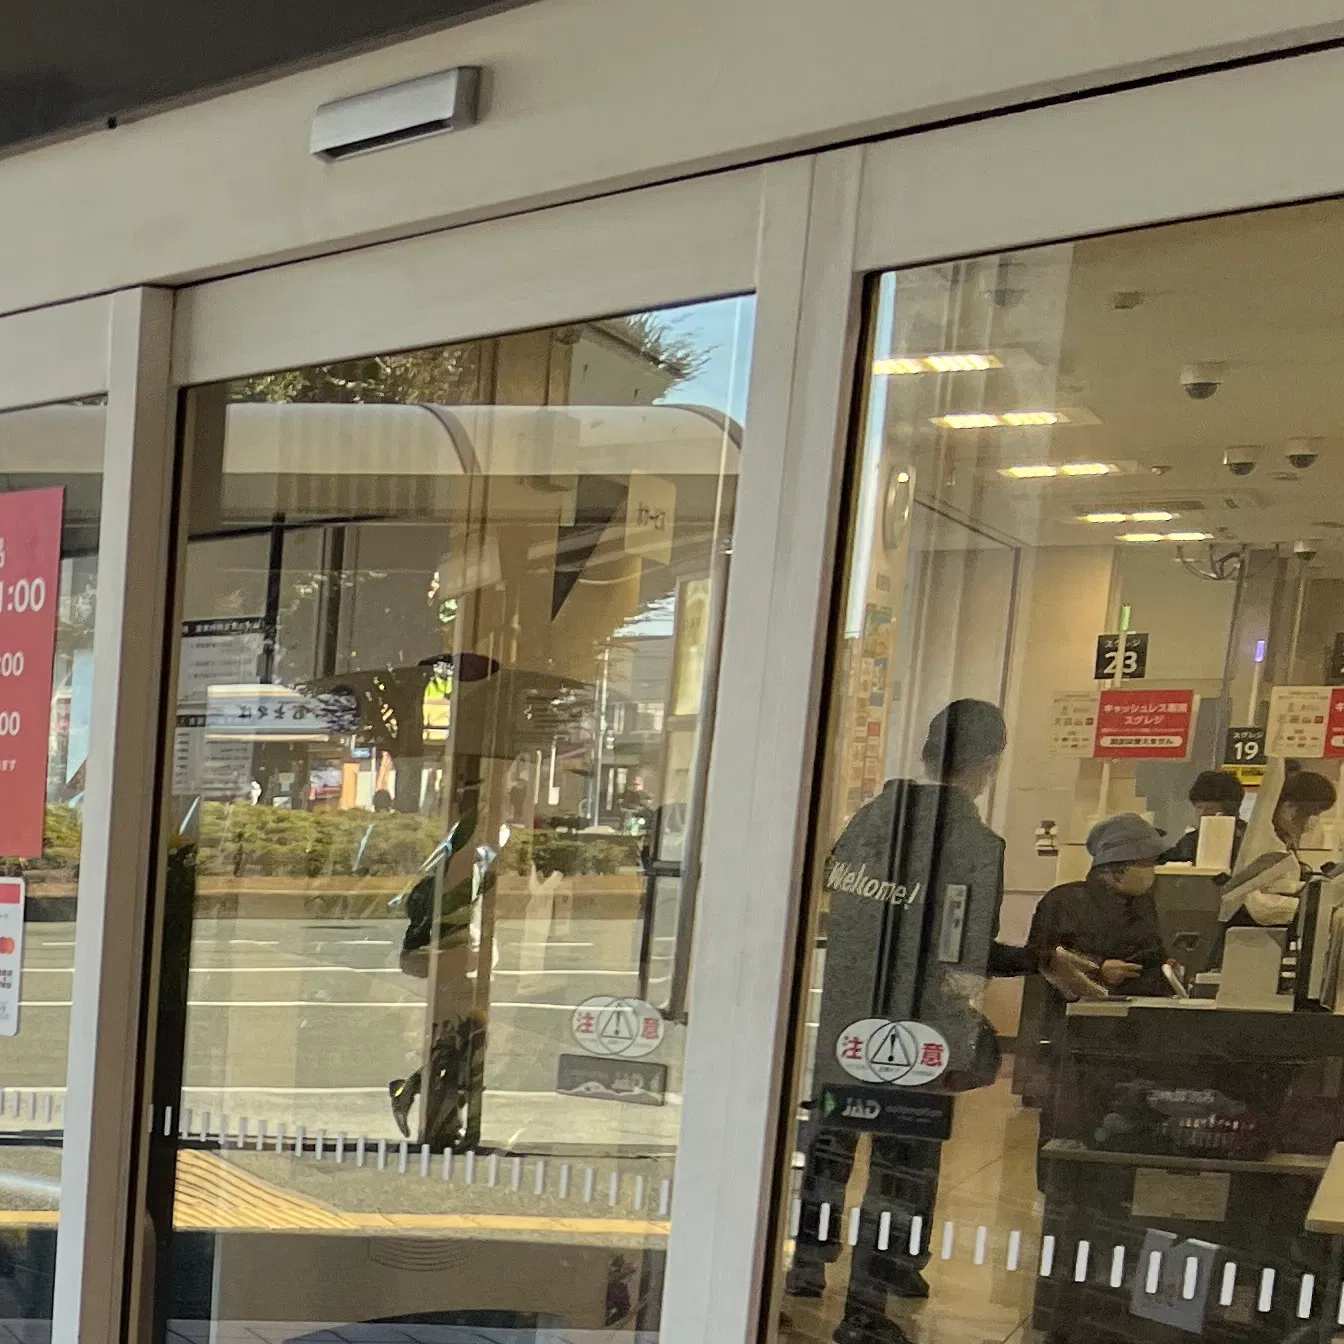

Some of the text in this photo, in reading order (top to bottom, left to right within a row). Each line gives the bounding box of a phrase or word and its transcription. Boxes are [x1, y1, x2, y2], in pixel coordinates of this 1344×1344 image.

[1103, 651, 1138, 675] 23
[1234, 741, 1260, 761] 19
[825, 861, 921, 910] Welcome!
[575, 1012, 660, 1039] 注 意
[842, 1035, 944, 1068] 注 意
